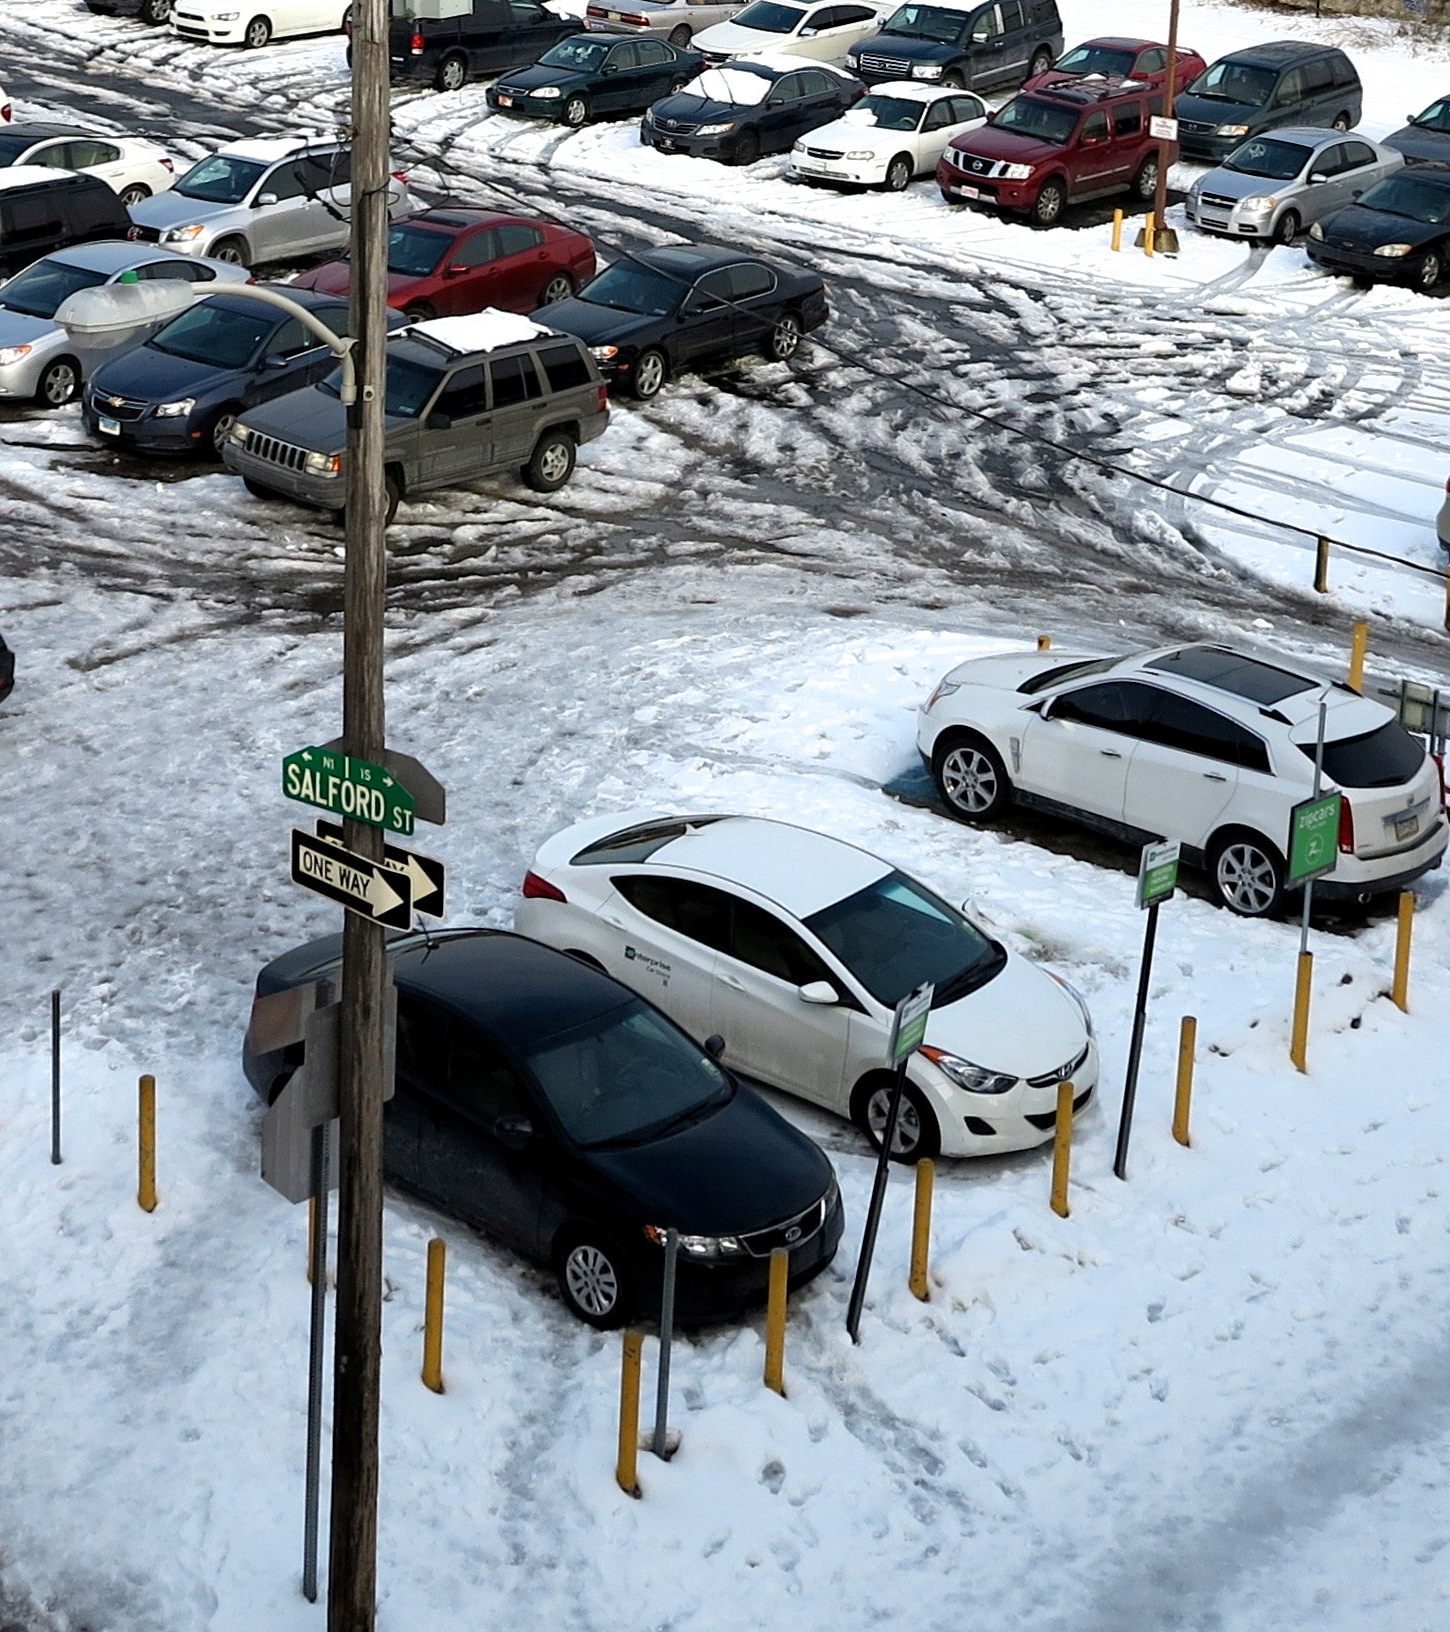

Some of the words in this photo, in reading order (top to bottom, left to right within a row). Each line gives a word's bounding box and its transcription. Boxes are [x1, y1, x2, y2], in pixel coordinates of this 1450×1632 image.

[286, 763, 386, 823] SALFORD
[392, 805, 413, 833] ST
[1299, 804, 1335, 829] zipcars
[302, 850, 334, 882] ONE
[338, 867, 371, 899] WAY
